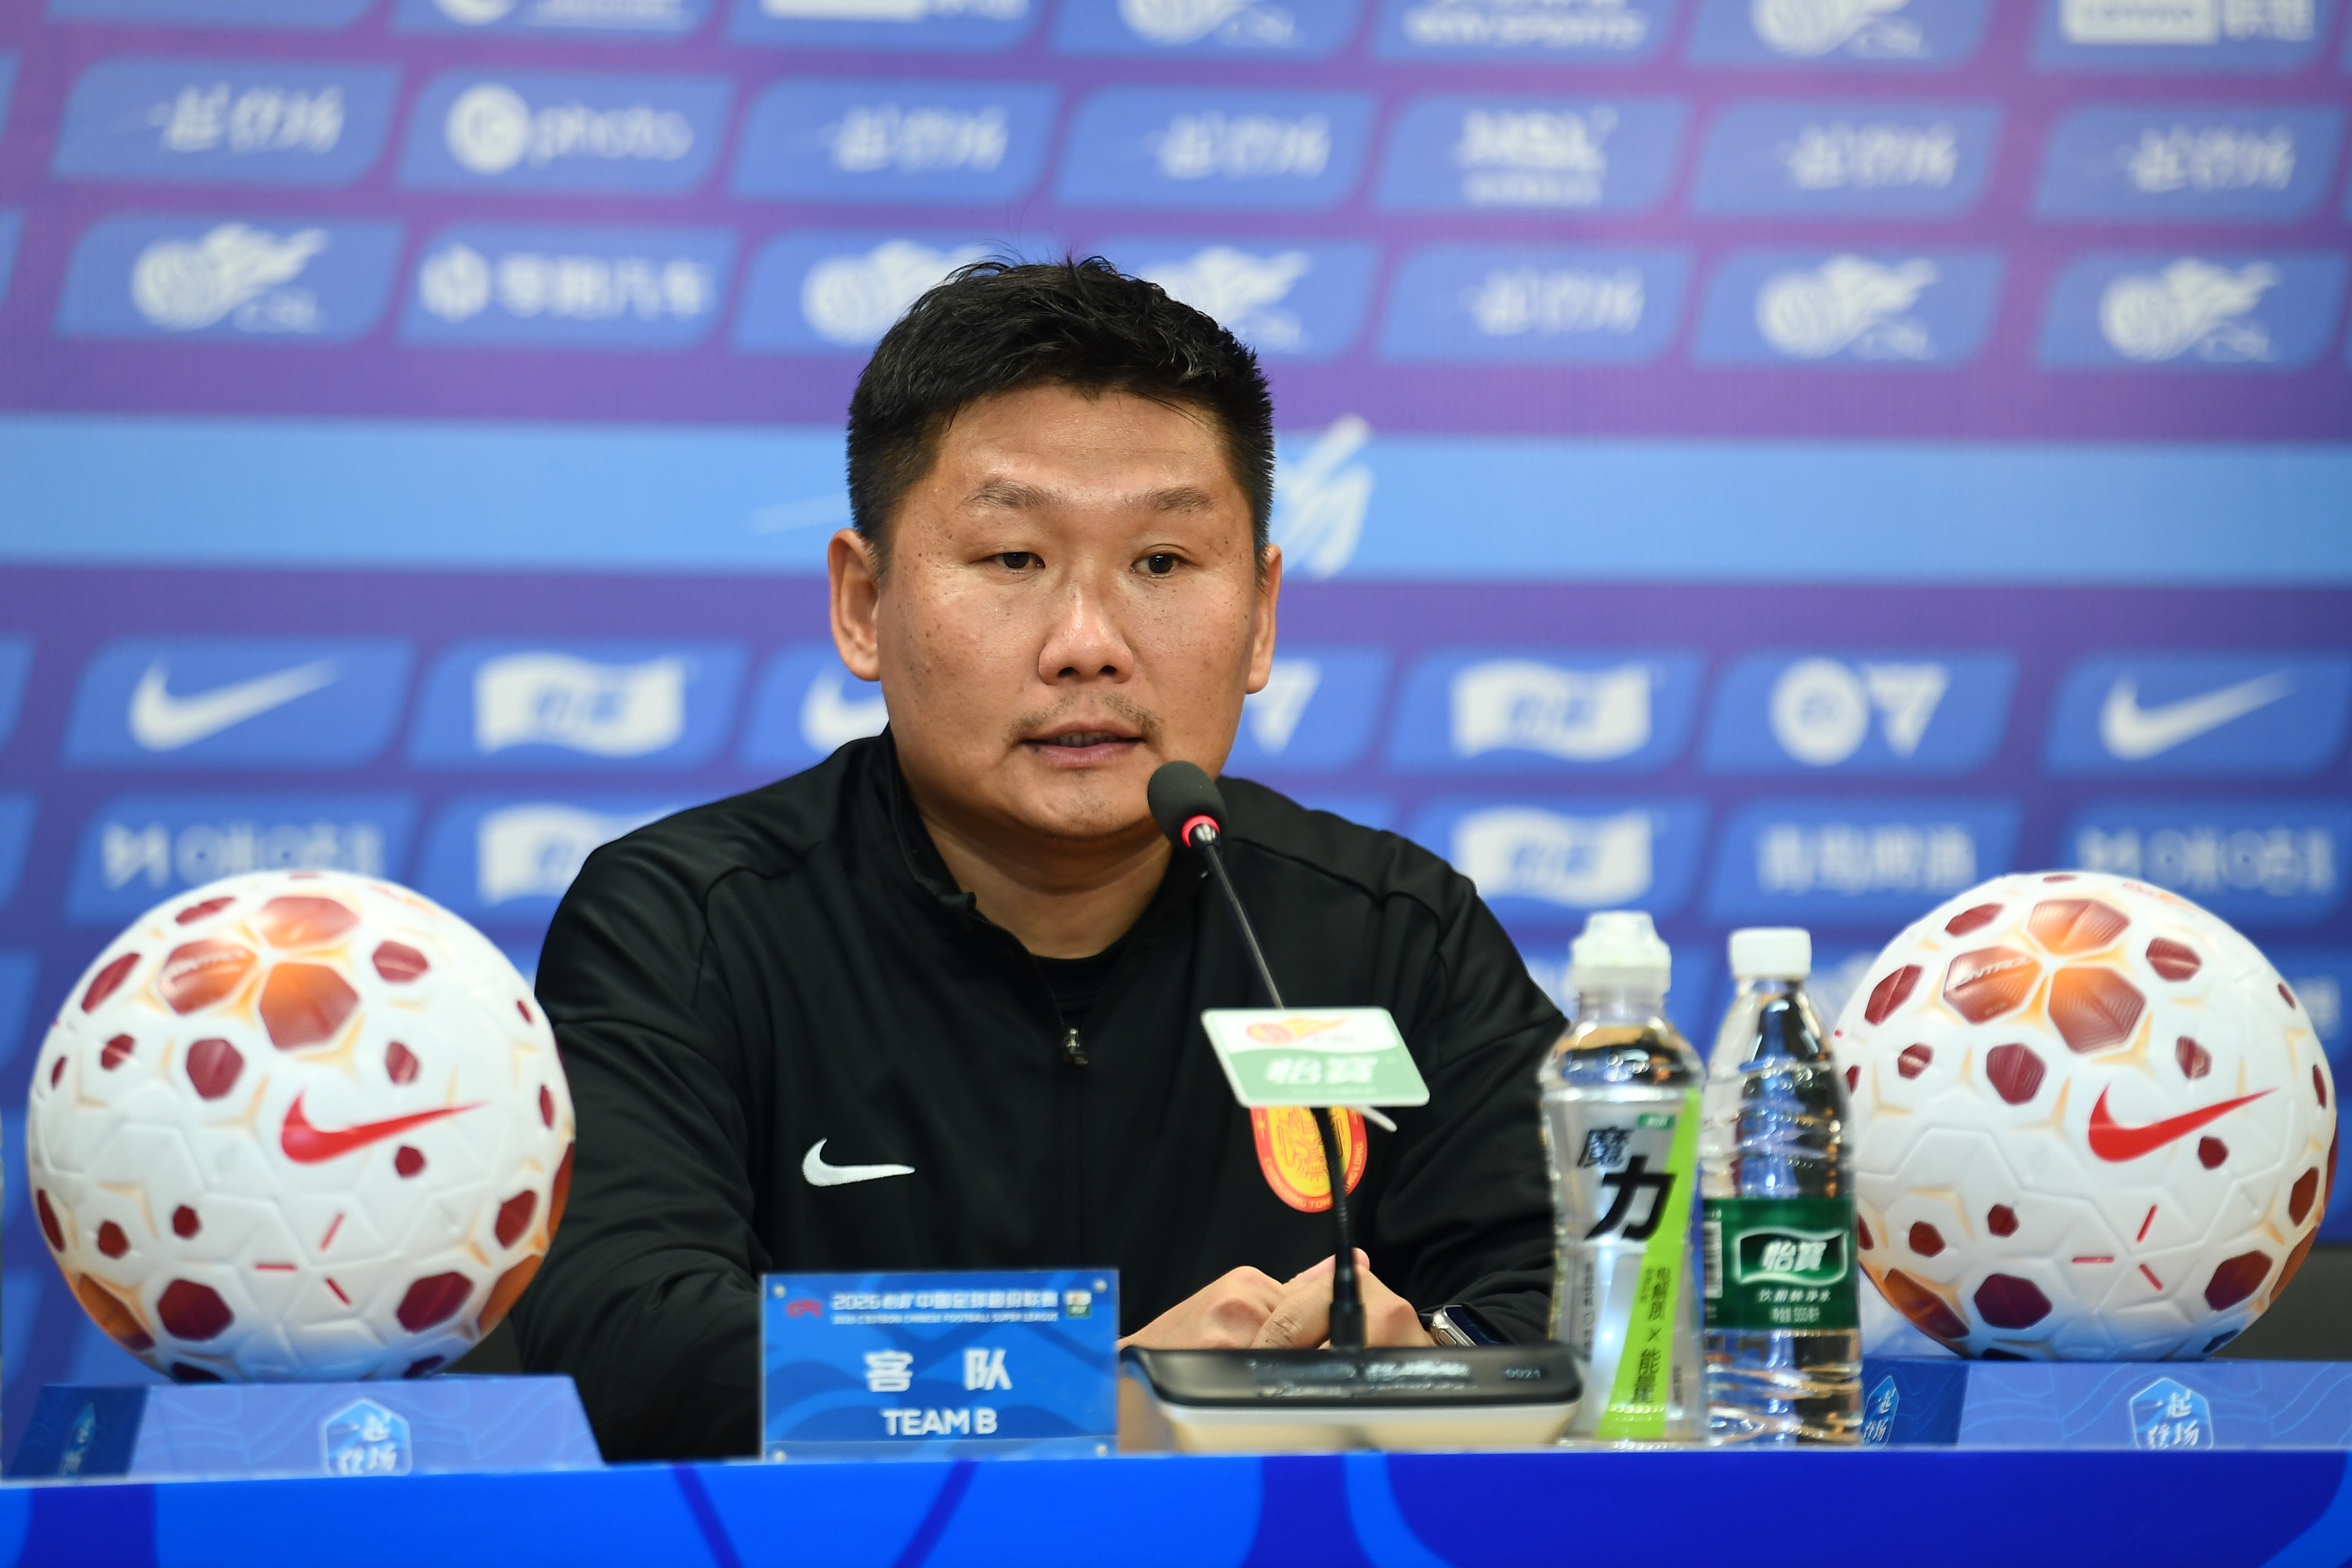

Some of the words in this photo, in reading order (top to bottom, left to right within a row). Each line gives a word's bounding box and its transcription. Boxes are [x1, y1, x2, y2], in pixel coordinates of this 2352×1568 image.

[865, 1350, 914, 1392] 客
[964, 1348, 1013, 1392] 队
[881, 1409, 971, 1436] TEAM
[975, 1408, 998, 1435] B
